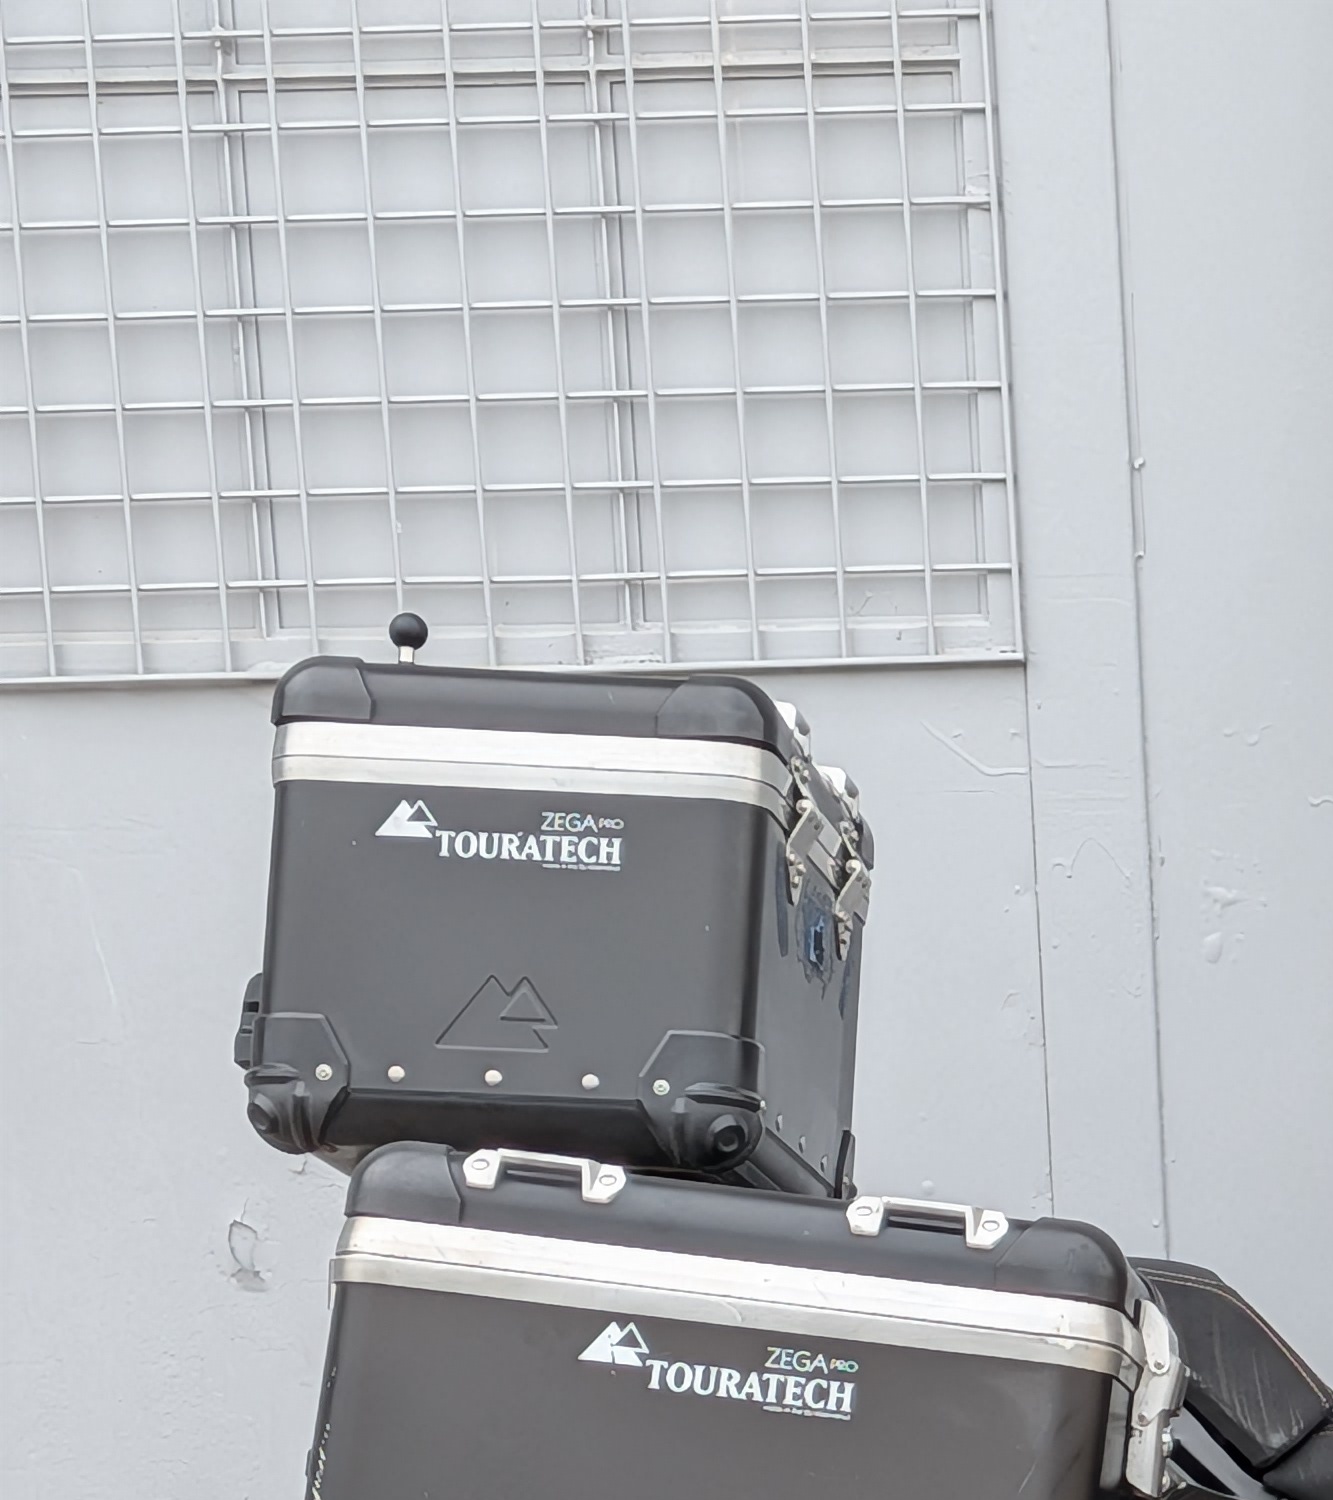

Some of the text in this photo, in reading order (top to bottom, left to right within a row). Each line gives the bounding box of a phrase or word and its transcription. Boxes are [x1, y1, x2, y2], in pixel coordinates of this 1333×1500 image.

[540, 811, 598, 833] ZEGA
[435, 829, 623, 865] TOURATECH
[764, 1346, 859, 1374] ZEGA PRO
[645, 1358, 857, 1413] TOURATECH
